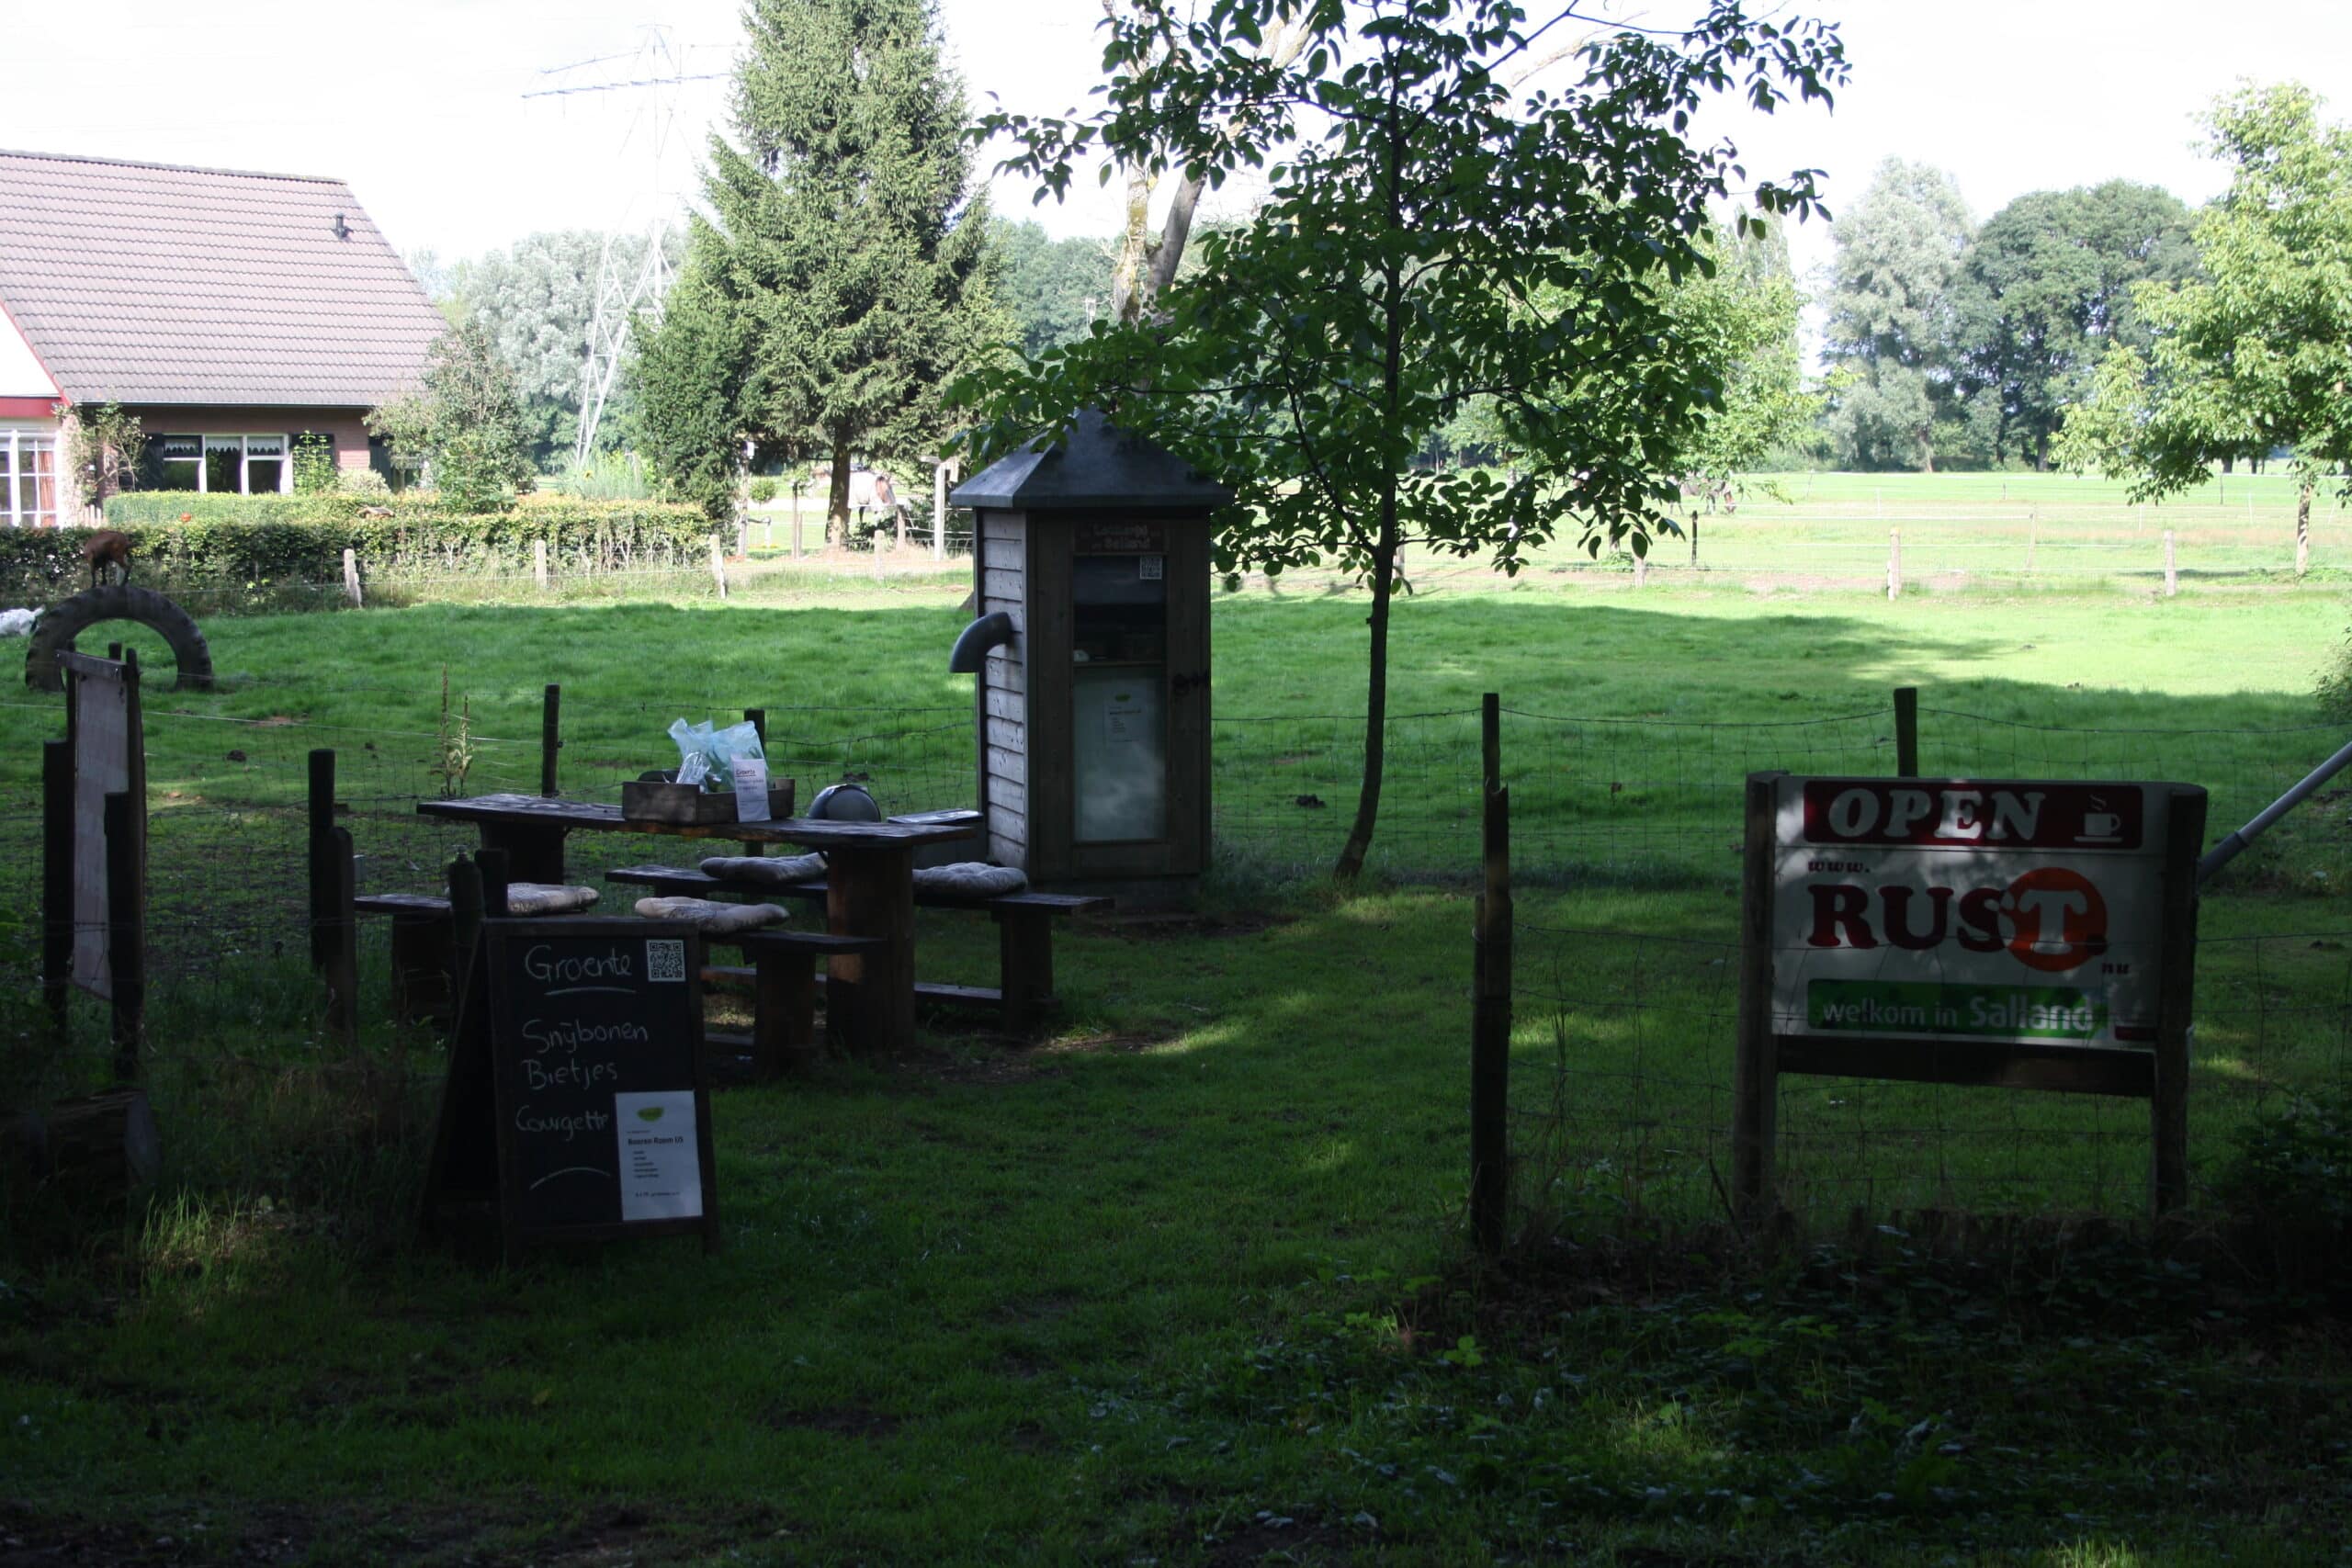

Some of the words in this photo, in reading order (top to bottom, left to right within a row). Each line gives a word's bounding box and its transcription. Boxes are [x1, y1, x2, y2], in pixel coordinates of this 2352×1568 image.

[1827, 786, 2047, 840] OPEN
[1807, 861, 1871, 874] www.
[525, 943, 632, 984] Groente
[1822, 998, 1927, 1027] welkom
[1935, 1001, 1958, 1026] in
[1969, 994, 2094, 1032] Salland
[520, 1058, 618, 1090] Bietjes
